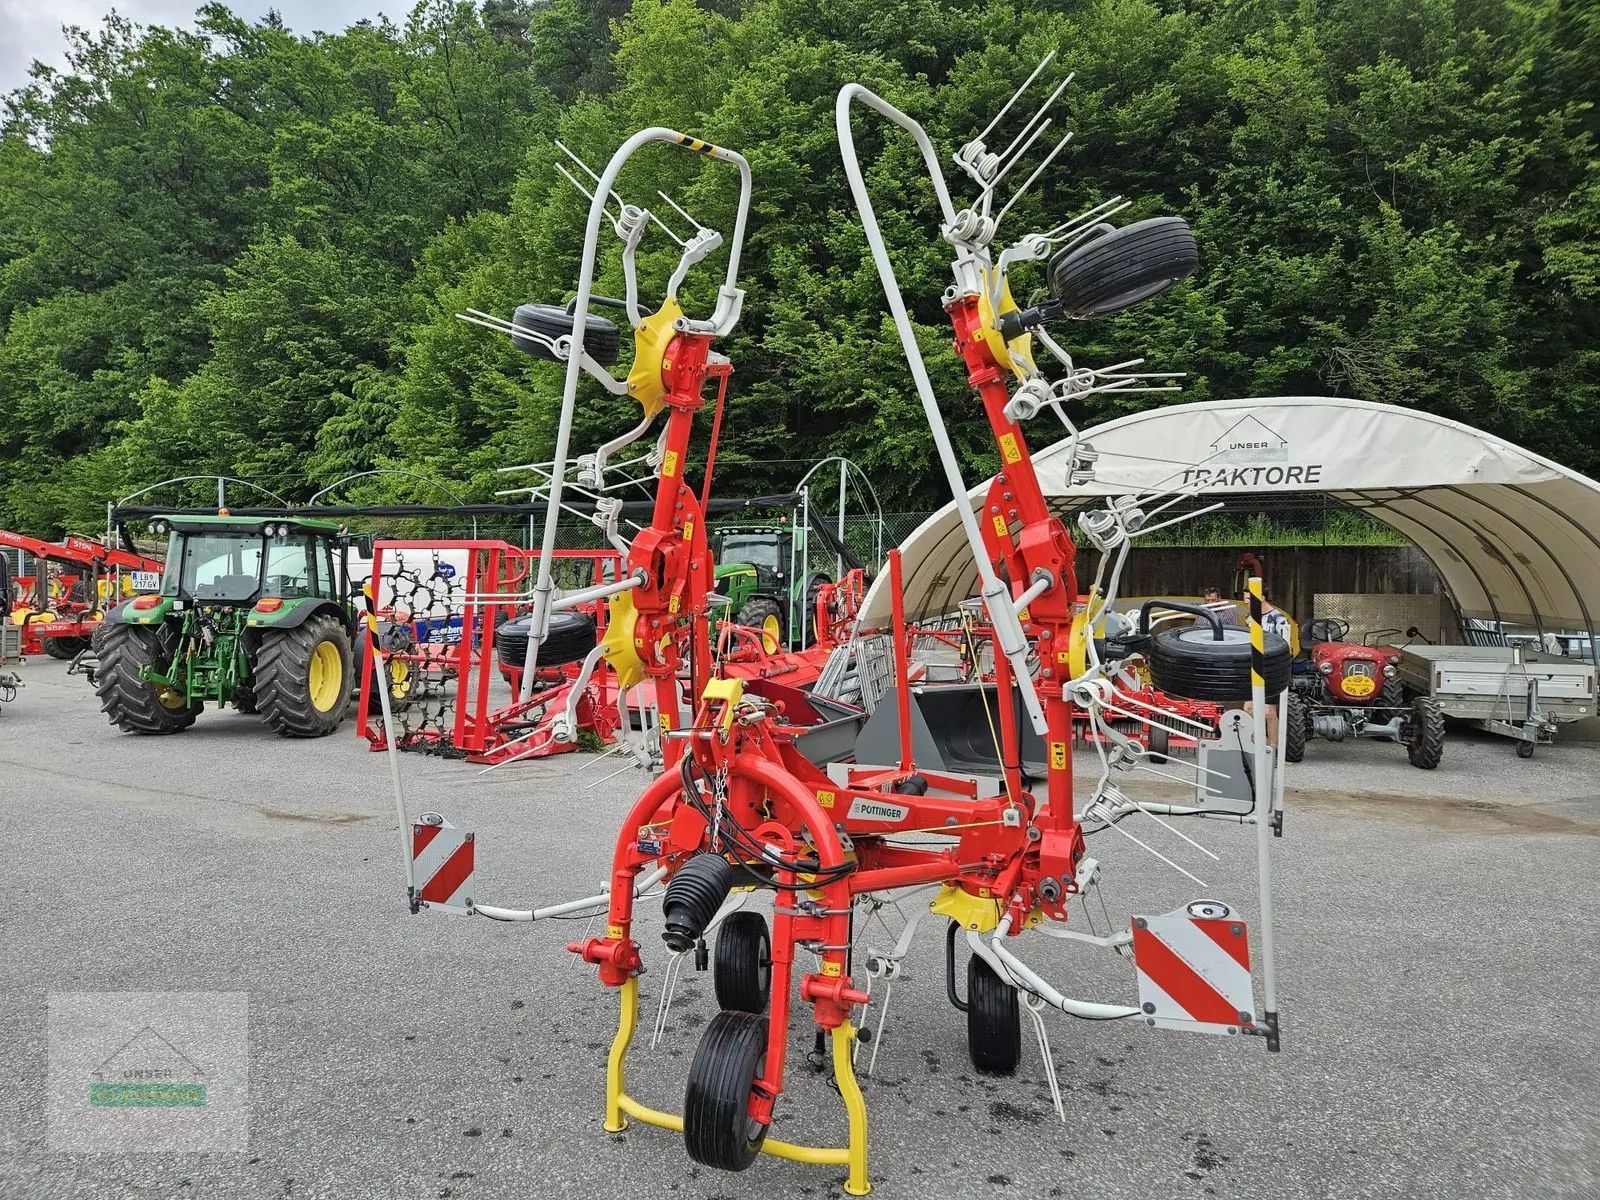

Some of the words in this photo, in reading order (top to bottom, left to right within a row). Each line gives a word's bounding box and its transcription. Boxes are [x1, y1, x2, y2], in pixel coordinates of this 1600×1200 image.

[1229, 442, 1268, 450] UNSER
[1182, 465, 1322, 487] TRAKTORE
[134, 580, 147, 588] 217
